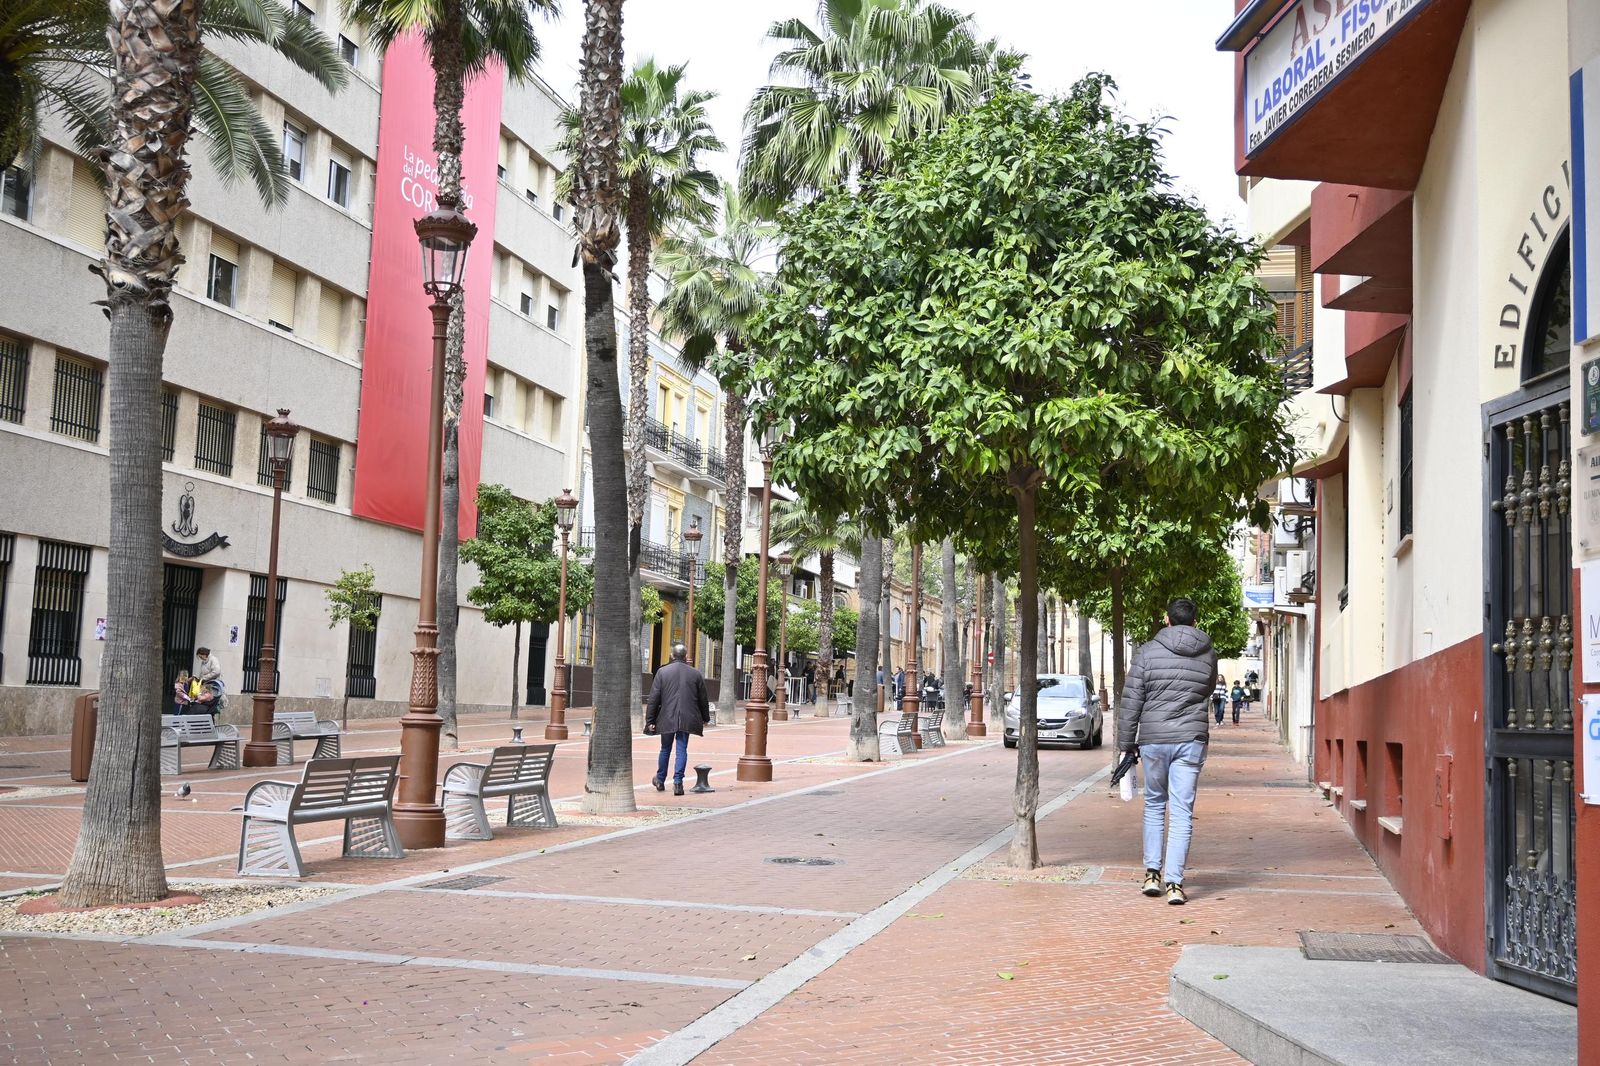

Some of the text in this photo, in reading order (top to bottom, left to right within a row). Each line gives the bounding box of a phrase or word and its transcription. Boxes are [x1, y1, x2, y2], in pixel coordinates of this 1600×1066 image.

[1254, 38, 1325, 124] LABORAL
[1341, 0, 1389, 45] FISC
[1264, 102, 1287, 136] JAVIER
[1289, 62, 1334, 113] CORREDERA
[1335, 22, 1375, 71] SESMERO
[403, 144, 415, 164] La
[403, 163, 414, 177] del
